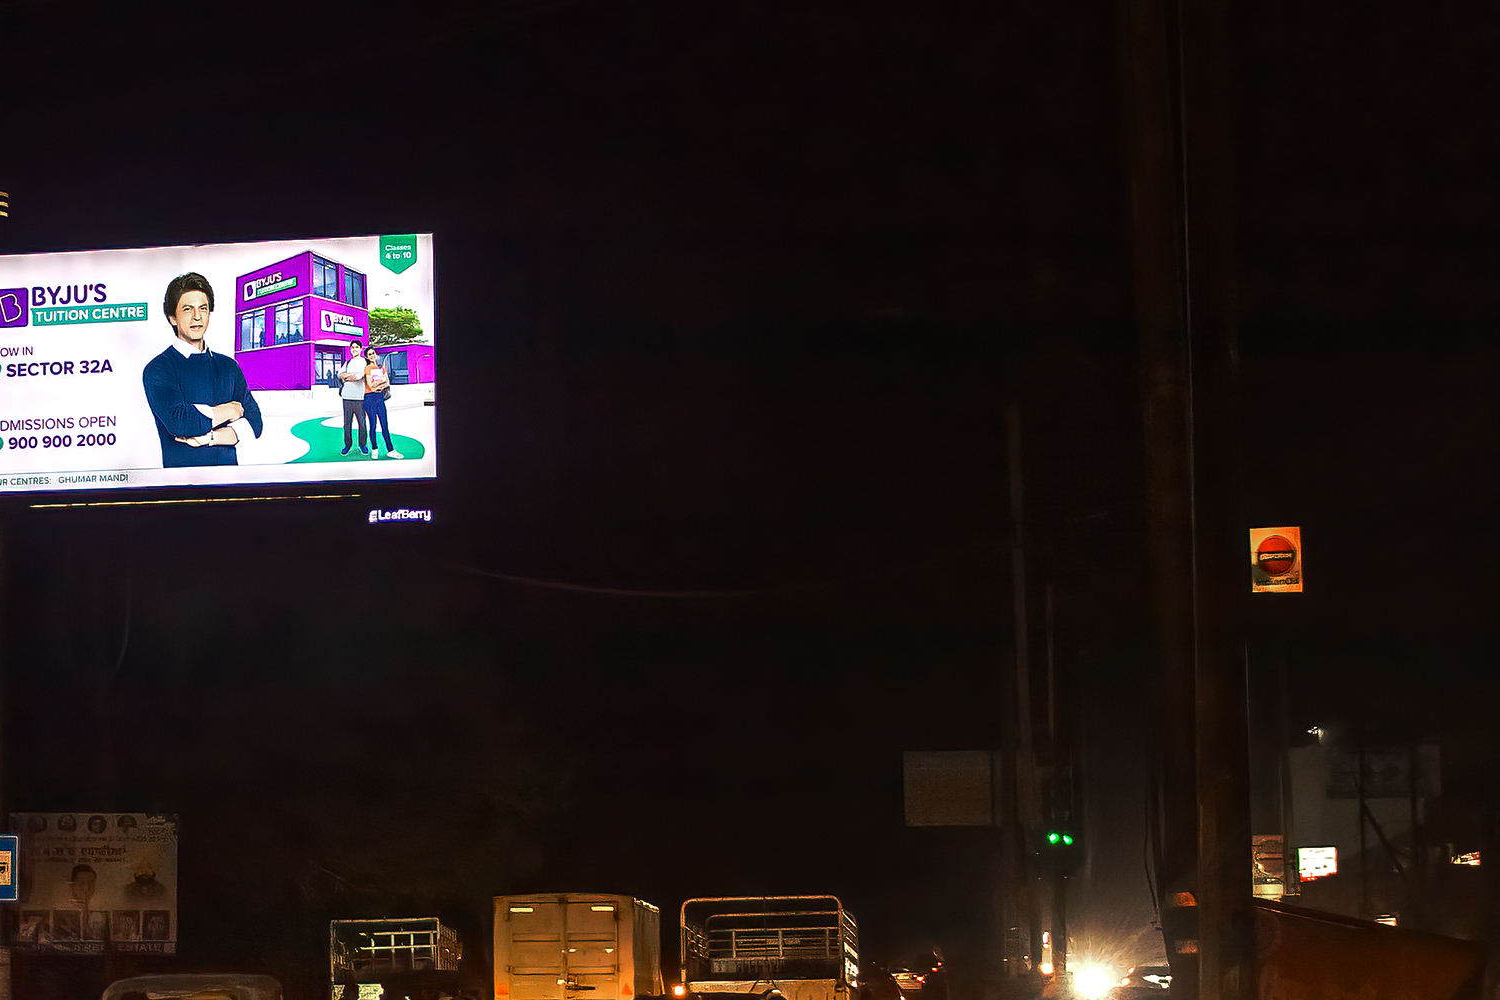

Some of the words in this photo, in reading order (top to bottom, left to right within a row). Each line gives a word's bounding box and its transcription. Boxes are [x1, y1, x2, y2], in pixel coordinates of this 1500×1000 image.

[402, 251, 412, 259] 10
[31, 283, 107, 306] BYJU'S
[35, 309, 89, 323] TUITION
[92, 306, 145, 320] CENTRE
[22, 346, 33, 356] IN
[6, 360, 74, 377] SECTOR
[79, 359, 113, 374] 32A
[78, 415, 117, 428] OPEN
[8, 436, 38, 450] 900
[42, 435, 72, 448] 900
[76, 433, 117, 446] 2000
[58, 474, 97, 484] GHUMAR
[99, 473, 129, 482] MANDI
